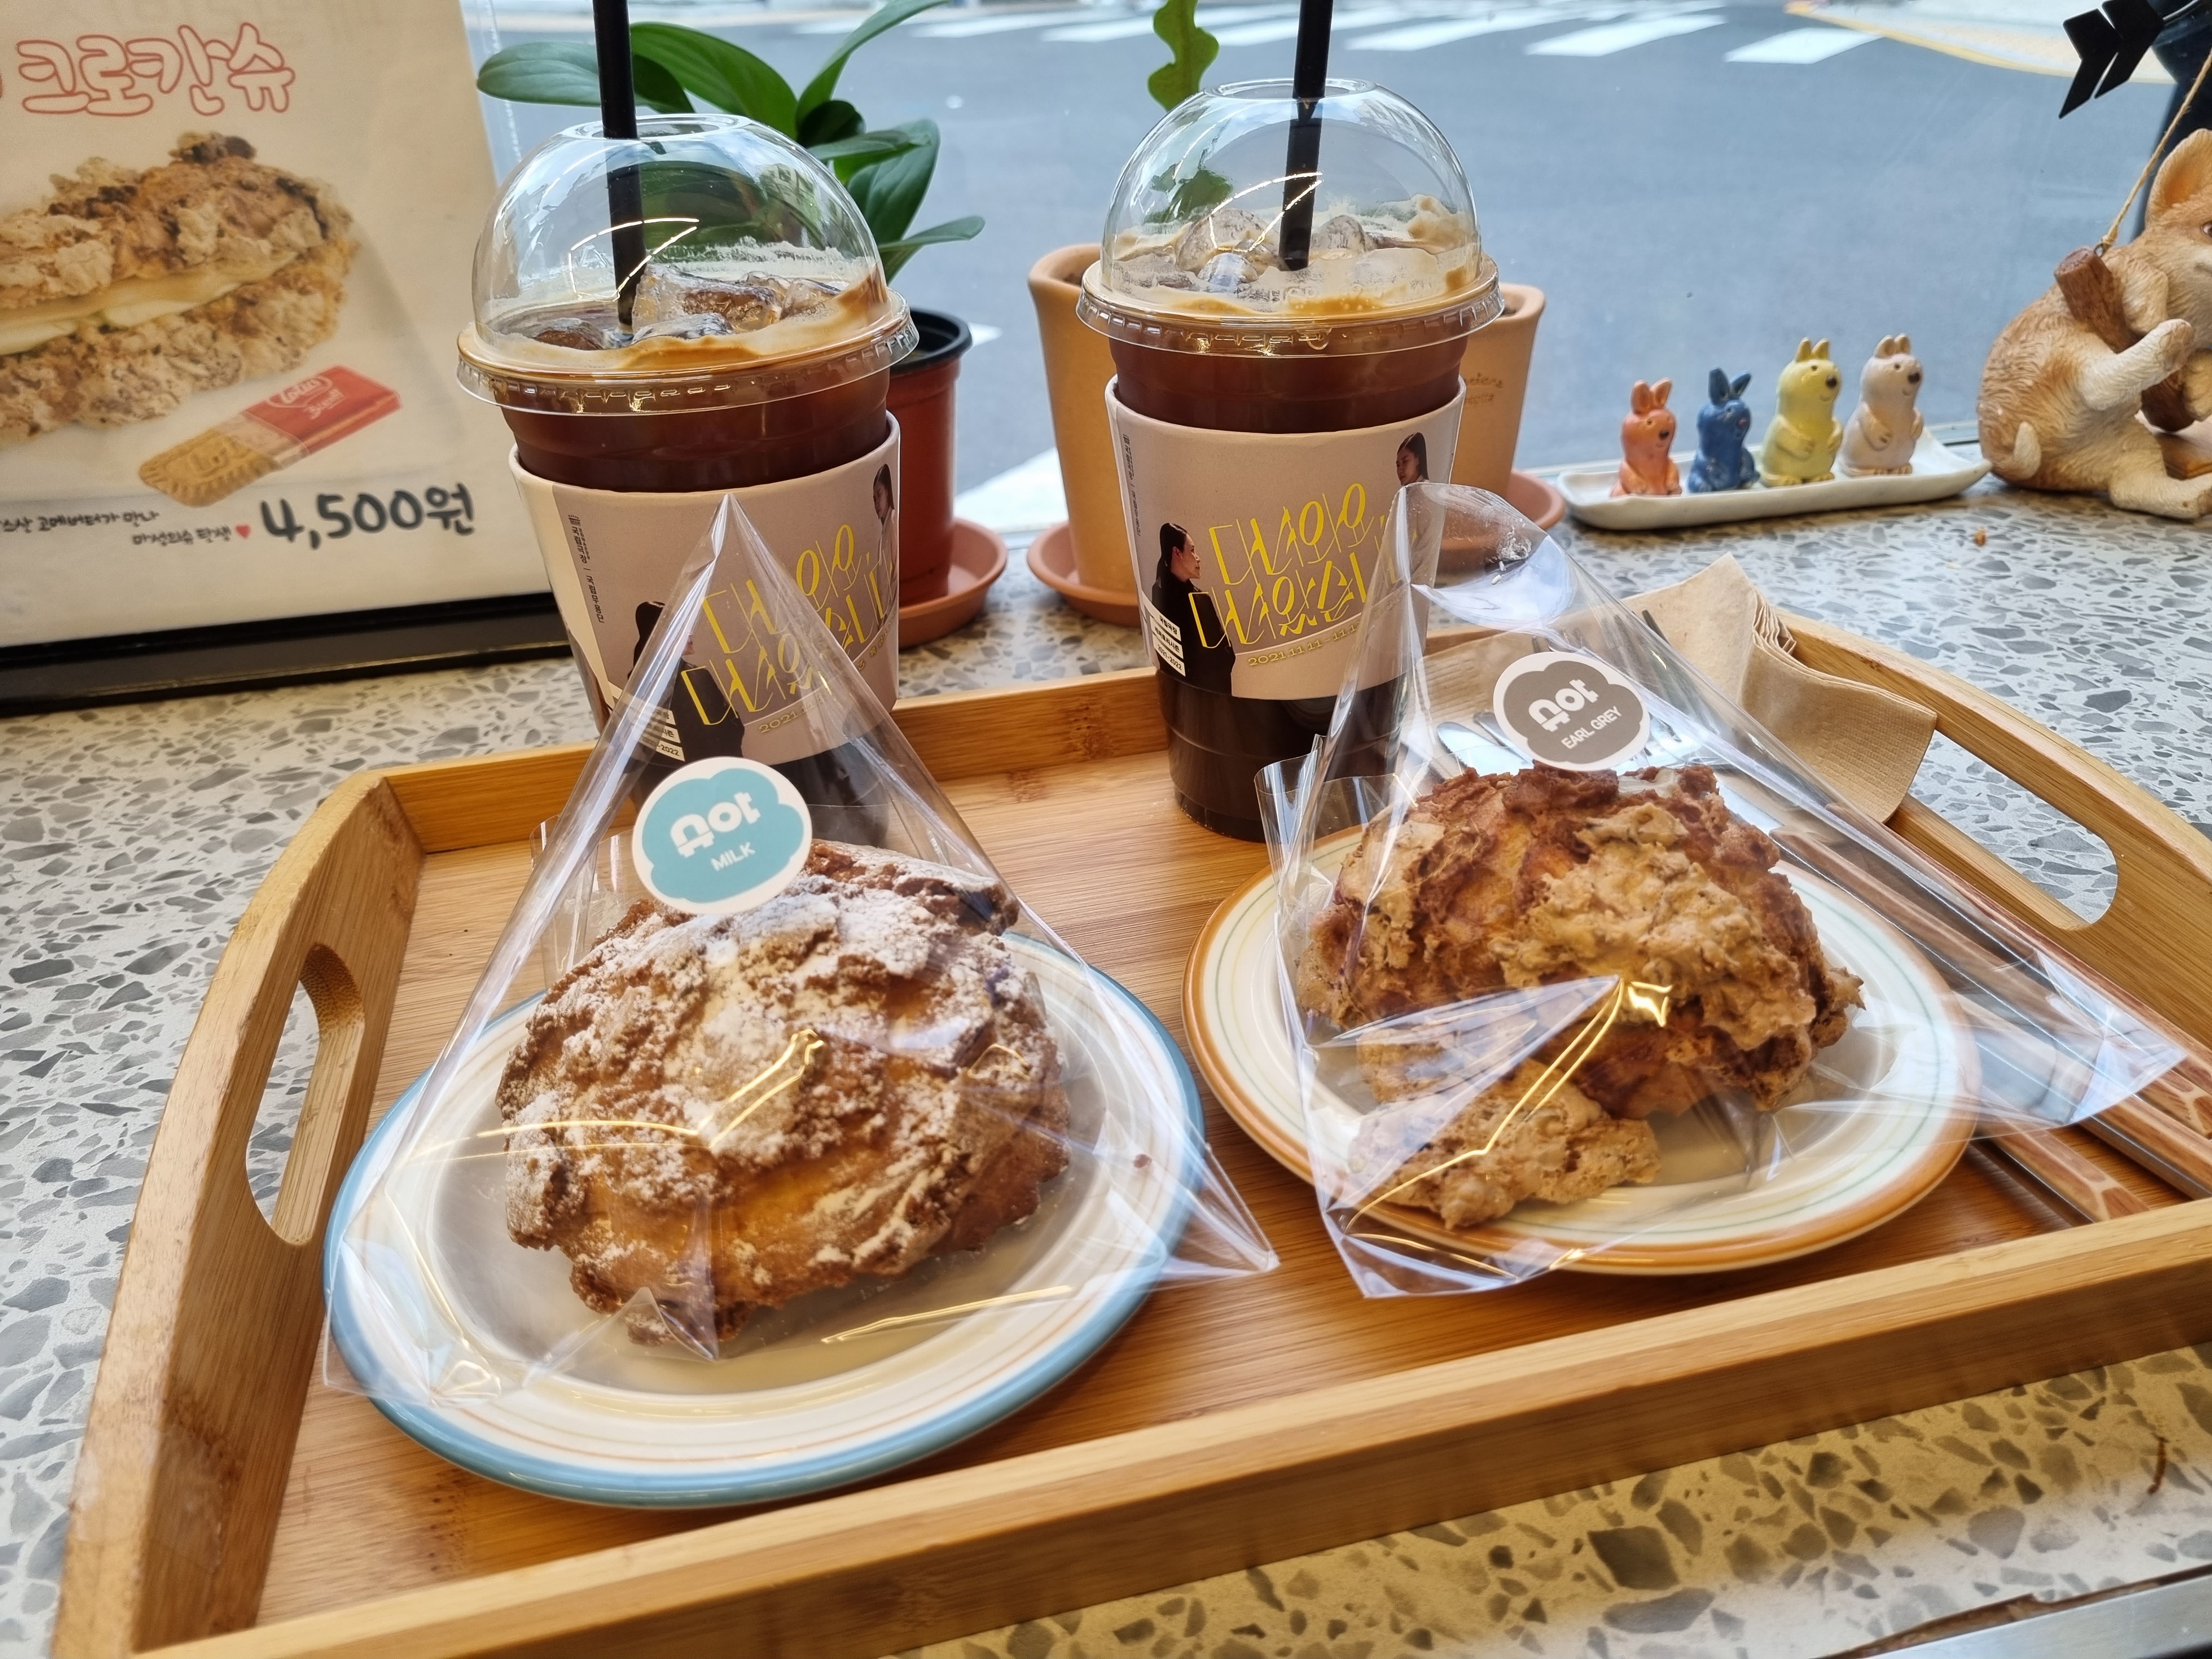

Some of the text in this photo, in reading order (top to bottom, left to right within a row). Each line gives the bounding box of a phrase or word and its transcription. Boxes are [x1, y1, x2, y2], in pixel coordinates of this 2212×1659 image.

[17, 21, 296, 116] 크로칸슈
[0, 511, 160, 534] 스산 고메버터가 만나
[261, 483, 476, 550] 4,500원
[1159, 615, 1178, 635] 국립극장
[1158, 644, 1182, 670] 2021-2022
[1248, 639, 1323, 666] 2021.11.11
[1332, 621, 1361, 641] 11.1
[1560, 706, 1622, 749] EARL GREY
[711, 841, 756, 871] MILK
